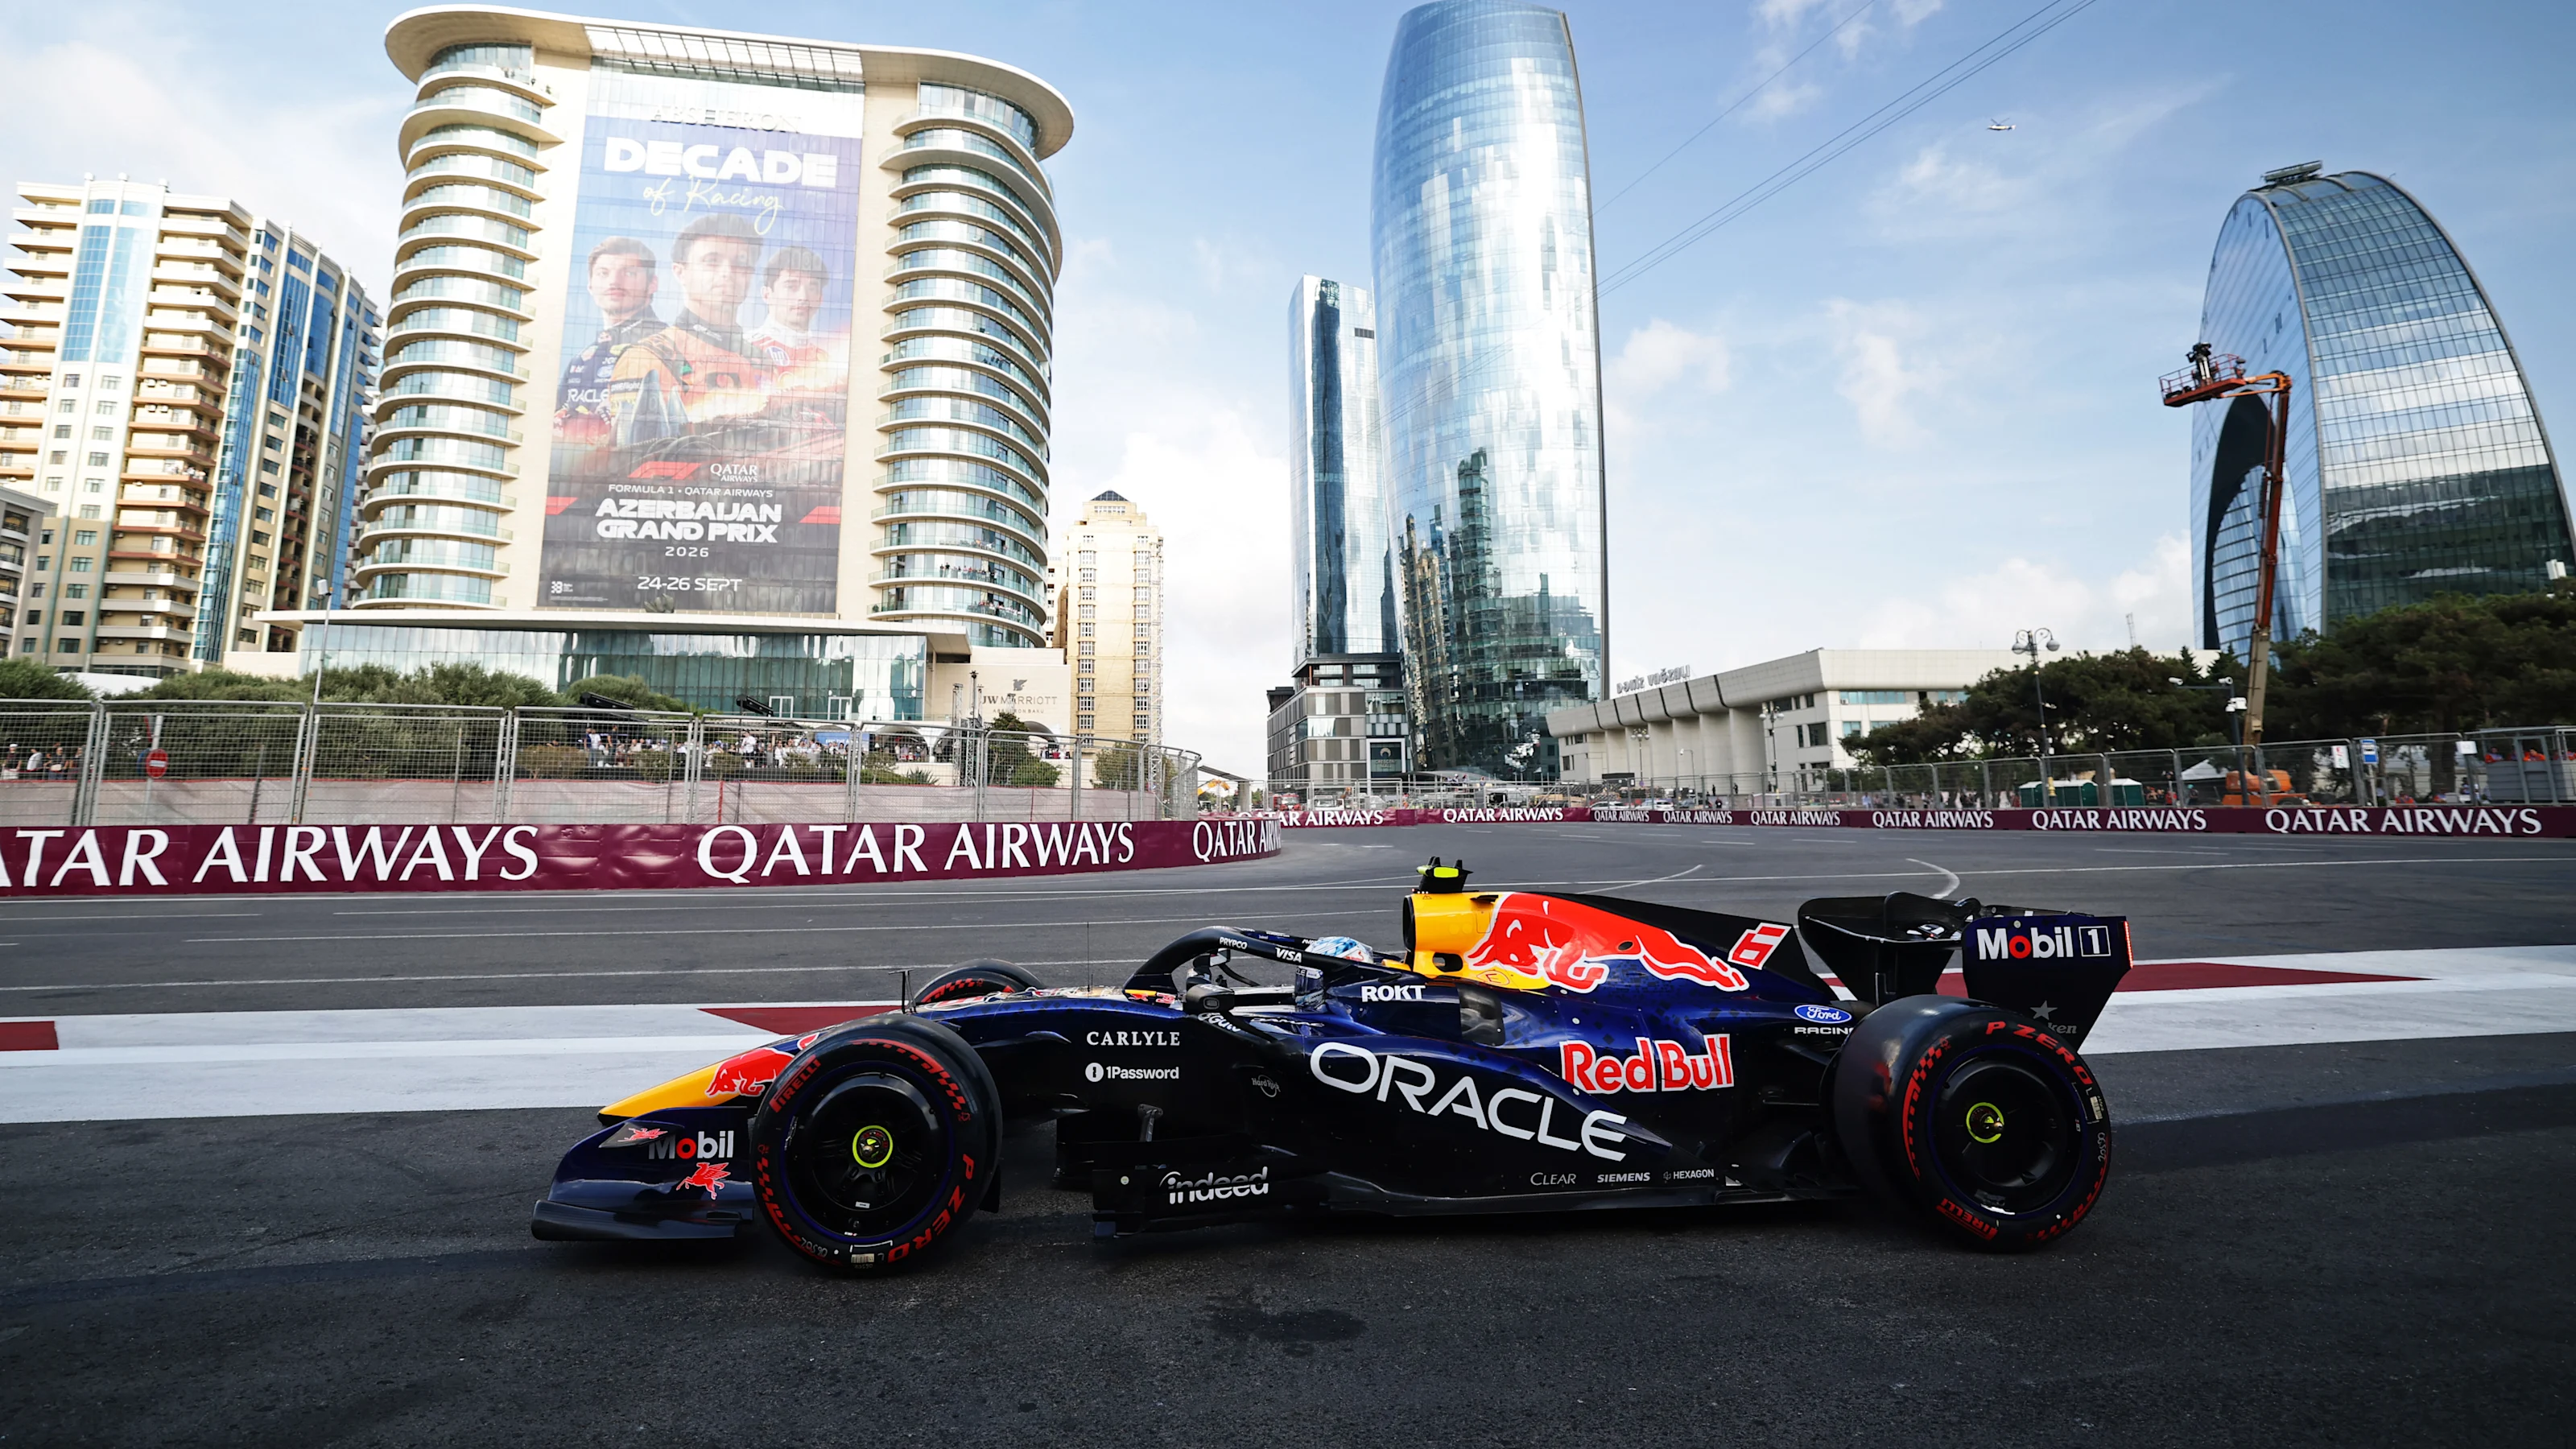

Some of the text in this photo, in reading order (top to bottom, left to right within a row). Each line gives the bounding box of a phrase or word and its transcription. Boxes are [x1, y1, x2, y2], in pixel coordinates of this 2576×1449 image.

[604, 136, 838, 188] DECADE
[643, 174, 786, 235] of Racing
[710, 463, 758, 477] QATAR
[720, 474, 758, 483] AIRWAYS
[609, 484, 774, 497] FORMULA 1 QATAR AIRWAYS
[595, 497, 782, 523] AZERBAIJAN
[597, 519, 778, 543] GRAND PRIX
[665, 546, 709, 558] 2026
[637, 576, 743, 592] 24-26 SEPT
[982, 696, 999, 704] JW
[1305, 810, 1384, 826] AIRWAYS
[1443, 807, 1563, 824] QATAR AIRWAYS
[1594, 810, 1649, 822] QATAR AIRWAYS
[1662, 811, 1733, 824] QATAR AIRWAYS
[1750, 811, 1841, 826] QATAR AIRWAYS
[1872, 810, 1994, 828] QATAR AIRWAYS
[2032, 809, 2207, 831] QATAR AIRWAYS
[2265, 807, 2542, 834] QATAR AIRWAYS
[1193, 820, 1257, 862] QATAR
[0, 824, 539, 886] TAR AIRWAYS
[697, 821, 1134, 884] QATAR AIRWAYS
[1219, 936, 1248, 950] PRYPCO
[1730, 924, 1789, 968] 6
[1977, 926, 2101, 960] Mobil 1
[1275, 947, 1303, 963] VISA
[1361, 985, 1426, 1002] ROKT
[1806, 1006, 1842, 1020] Ford
[1086, 1030, 1180, 1046] CARLYLE
[1794, 1026, 1855, 1035] RACIN
[1986, 1021, 2093, 1084] P ZERO
[1563, 1035, 1733, 1092] Red Bull
[1105, 1065, 1179, 1080] 1Password
[769, 1055, 821, 1113] PIRELLI
[1251, 1077, 1282, 1092] Hard Rock
[1310, 1042, 1628, 1162] ORACLE
[648, 1129, 734, 1160] Mobil
[1530, 1172, 1577, 1186] CLEAR
[1596, 1171, 1651, 1183] SIEMENS
[1673, 1168, 1715, 1179] HEXAGON
[1159, 1166, 1269, 1204] indeed
[887, 1154, 975, 1263] P ZERO
[1935, 1197, 1999, 1241] PIRELLI
